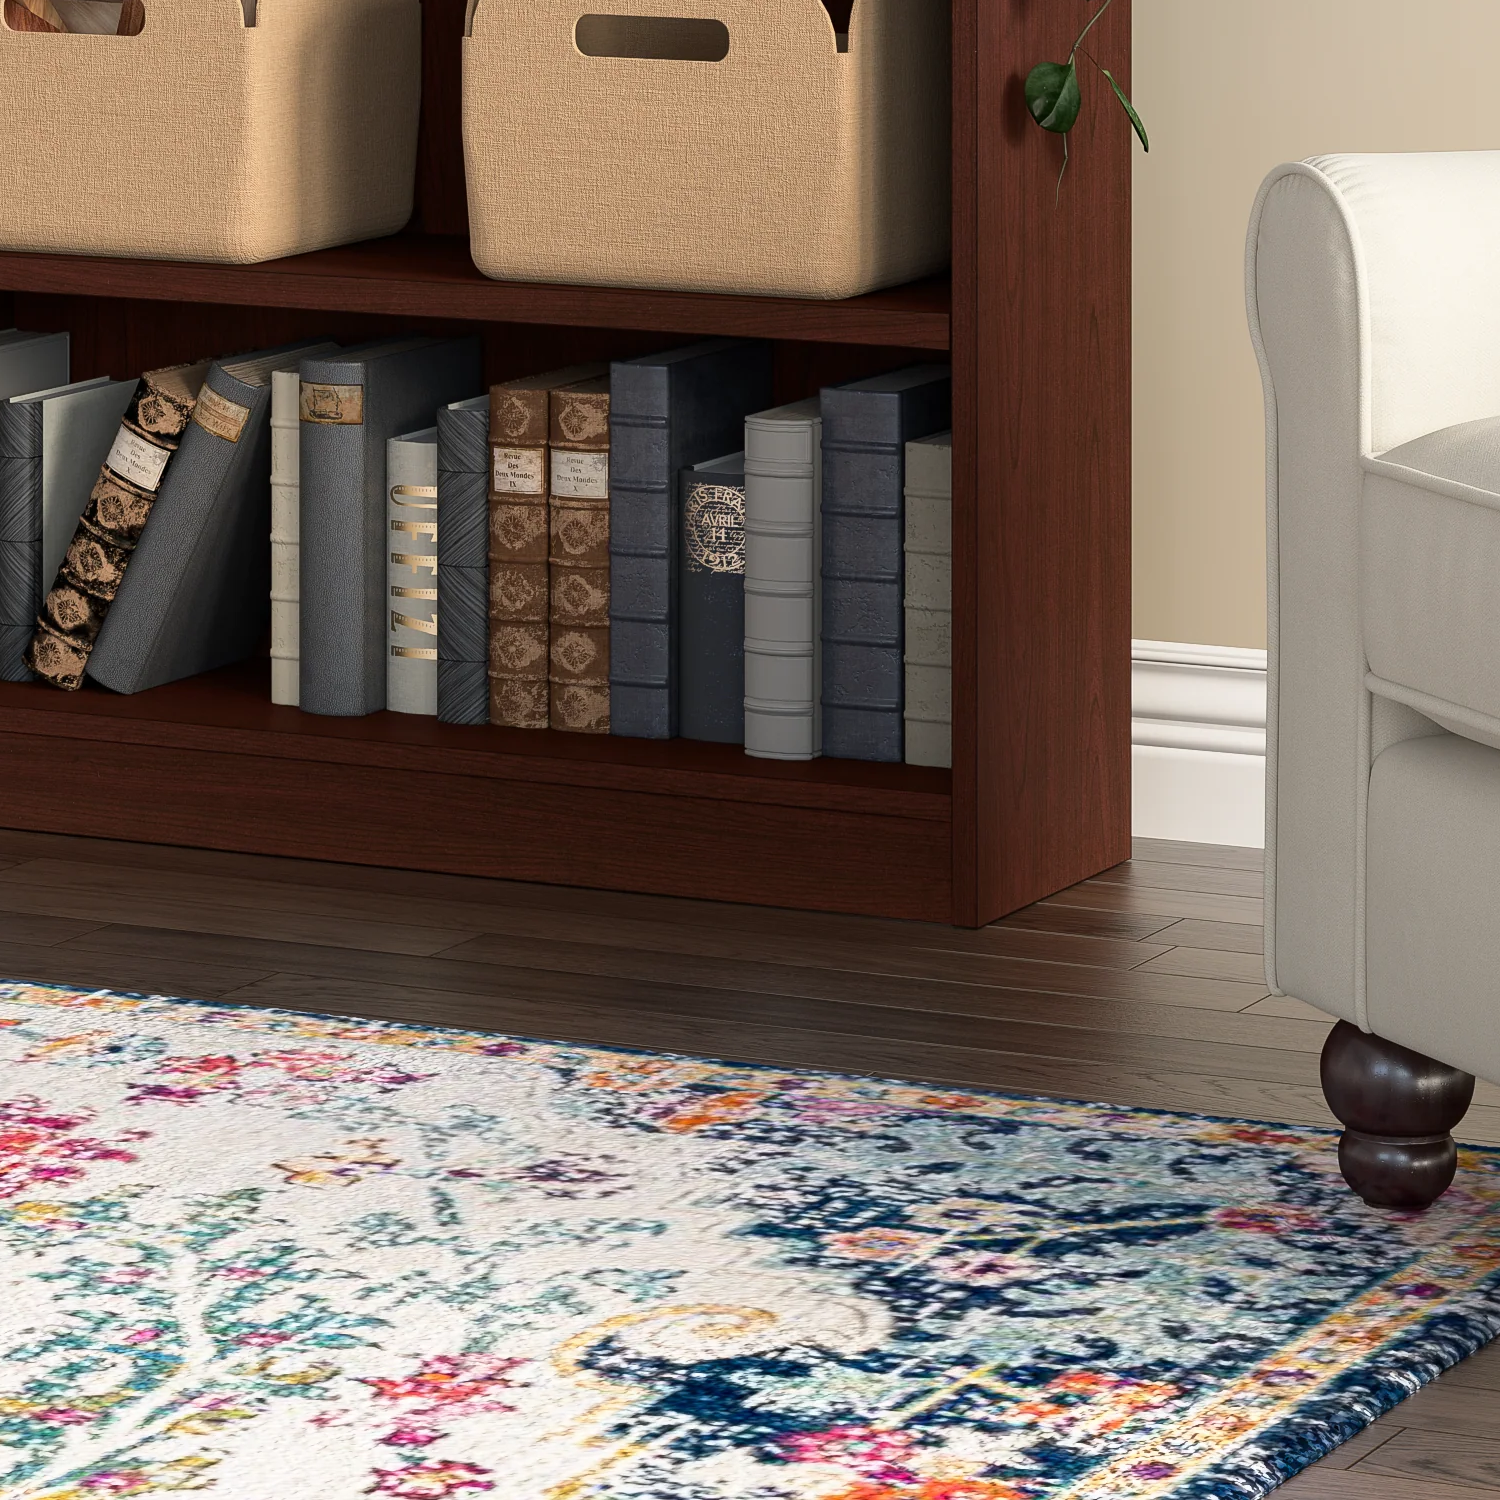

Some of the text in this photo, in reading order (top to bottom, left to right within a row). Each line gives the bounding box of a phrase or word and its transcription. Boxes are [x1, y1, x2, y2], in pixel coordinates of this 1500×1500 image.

[130, 450, 140, 459] Des
[495, 470, 534, 479] Deux Mondes
[573, 476, 598, 484] Mondes
[702, 514, 738, 527] AVRIL
[712, 528, 727, 541] 14
[703, 551, 740, 570] 1912
